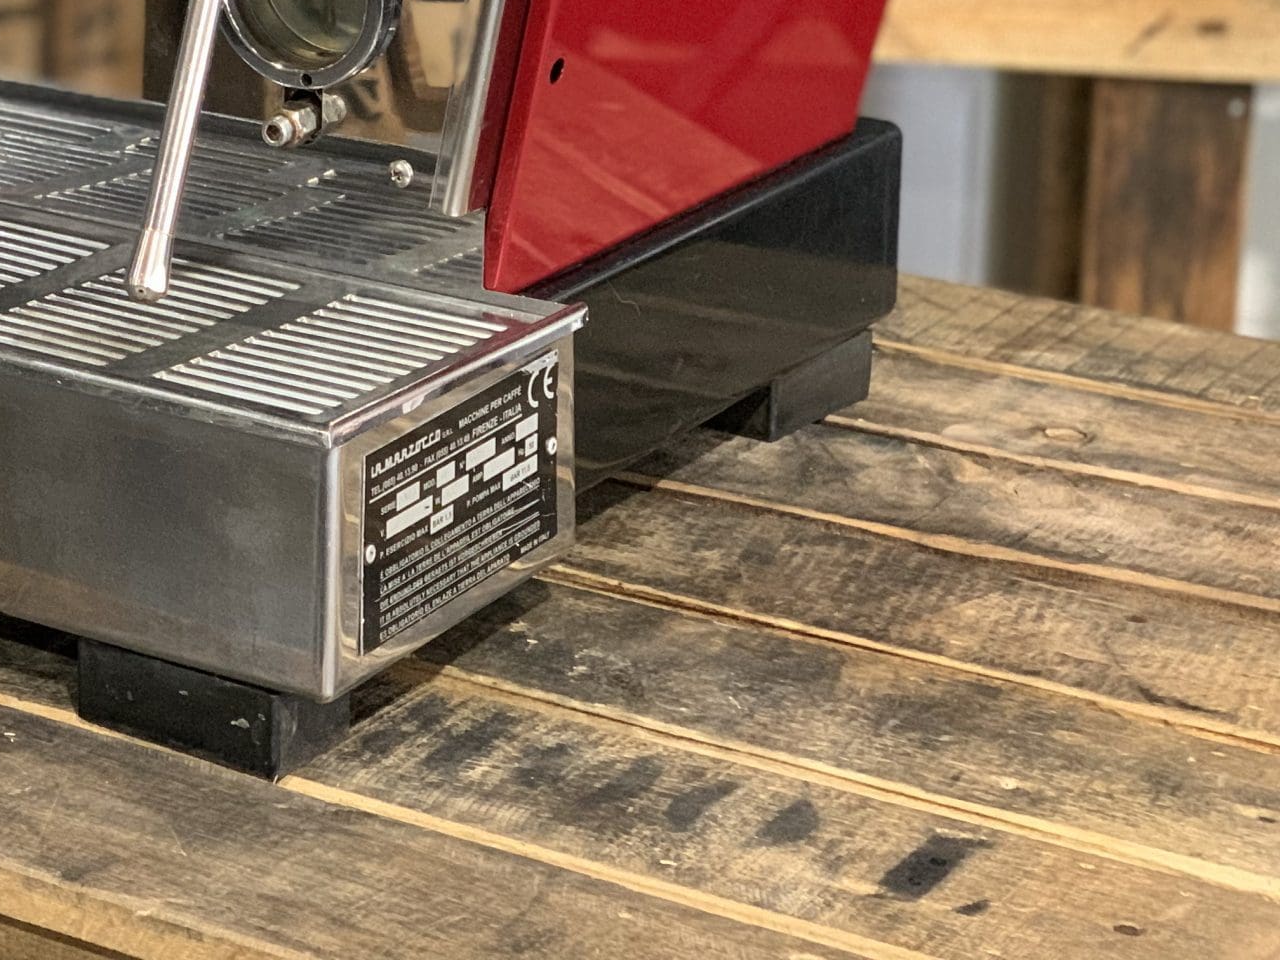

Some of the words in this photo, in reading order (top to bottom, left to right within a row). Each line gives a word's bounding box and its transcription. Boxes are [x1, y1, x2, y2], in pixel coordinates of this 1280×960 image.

[459, 404, 489, 428] MACCHINE
[490, 397, 502, 410] PER
[472, 416, 498, 437] FIRENZE
[503, 403, 521, 420] ITALIA
[371, 462, 381, 478] LA
[385, 430, 441, 470] MARZOCCO
